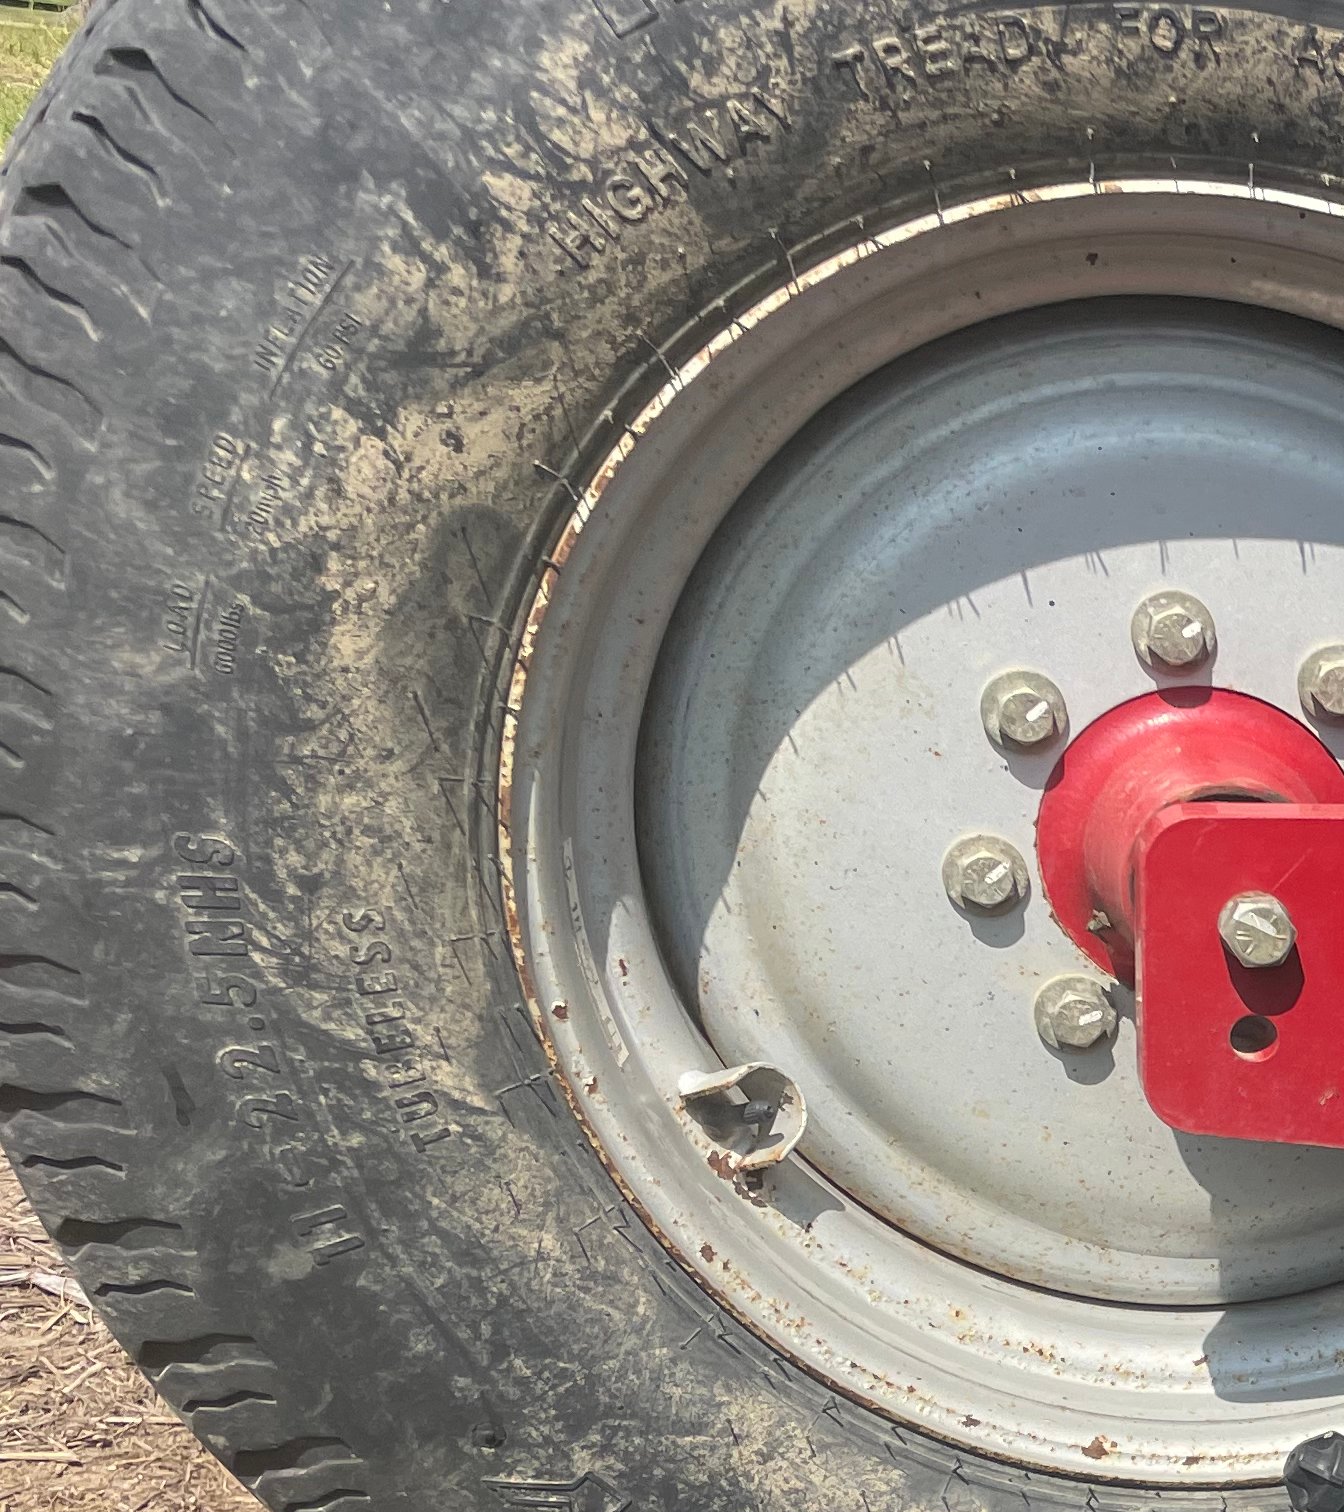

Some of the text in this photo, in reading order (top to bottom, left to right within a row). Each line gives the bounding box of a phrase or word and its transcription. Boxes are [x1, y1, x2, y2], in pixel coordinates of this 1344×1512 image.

[547, 87, 793, 270] HIGHWAY
[830, 15, 1034, 99] TREAD
[1117, 8, 1226, 66] FOR
[253, 254, 337, 373] INFLATION
[191, 432, 238, 517] SPEED
[163, 582, 195, 655] LOAD
[341, 907, 452, 1154] TUBELESS
